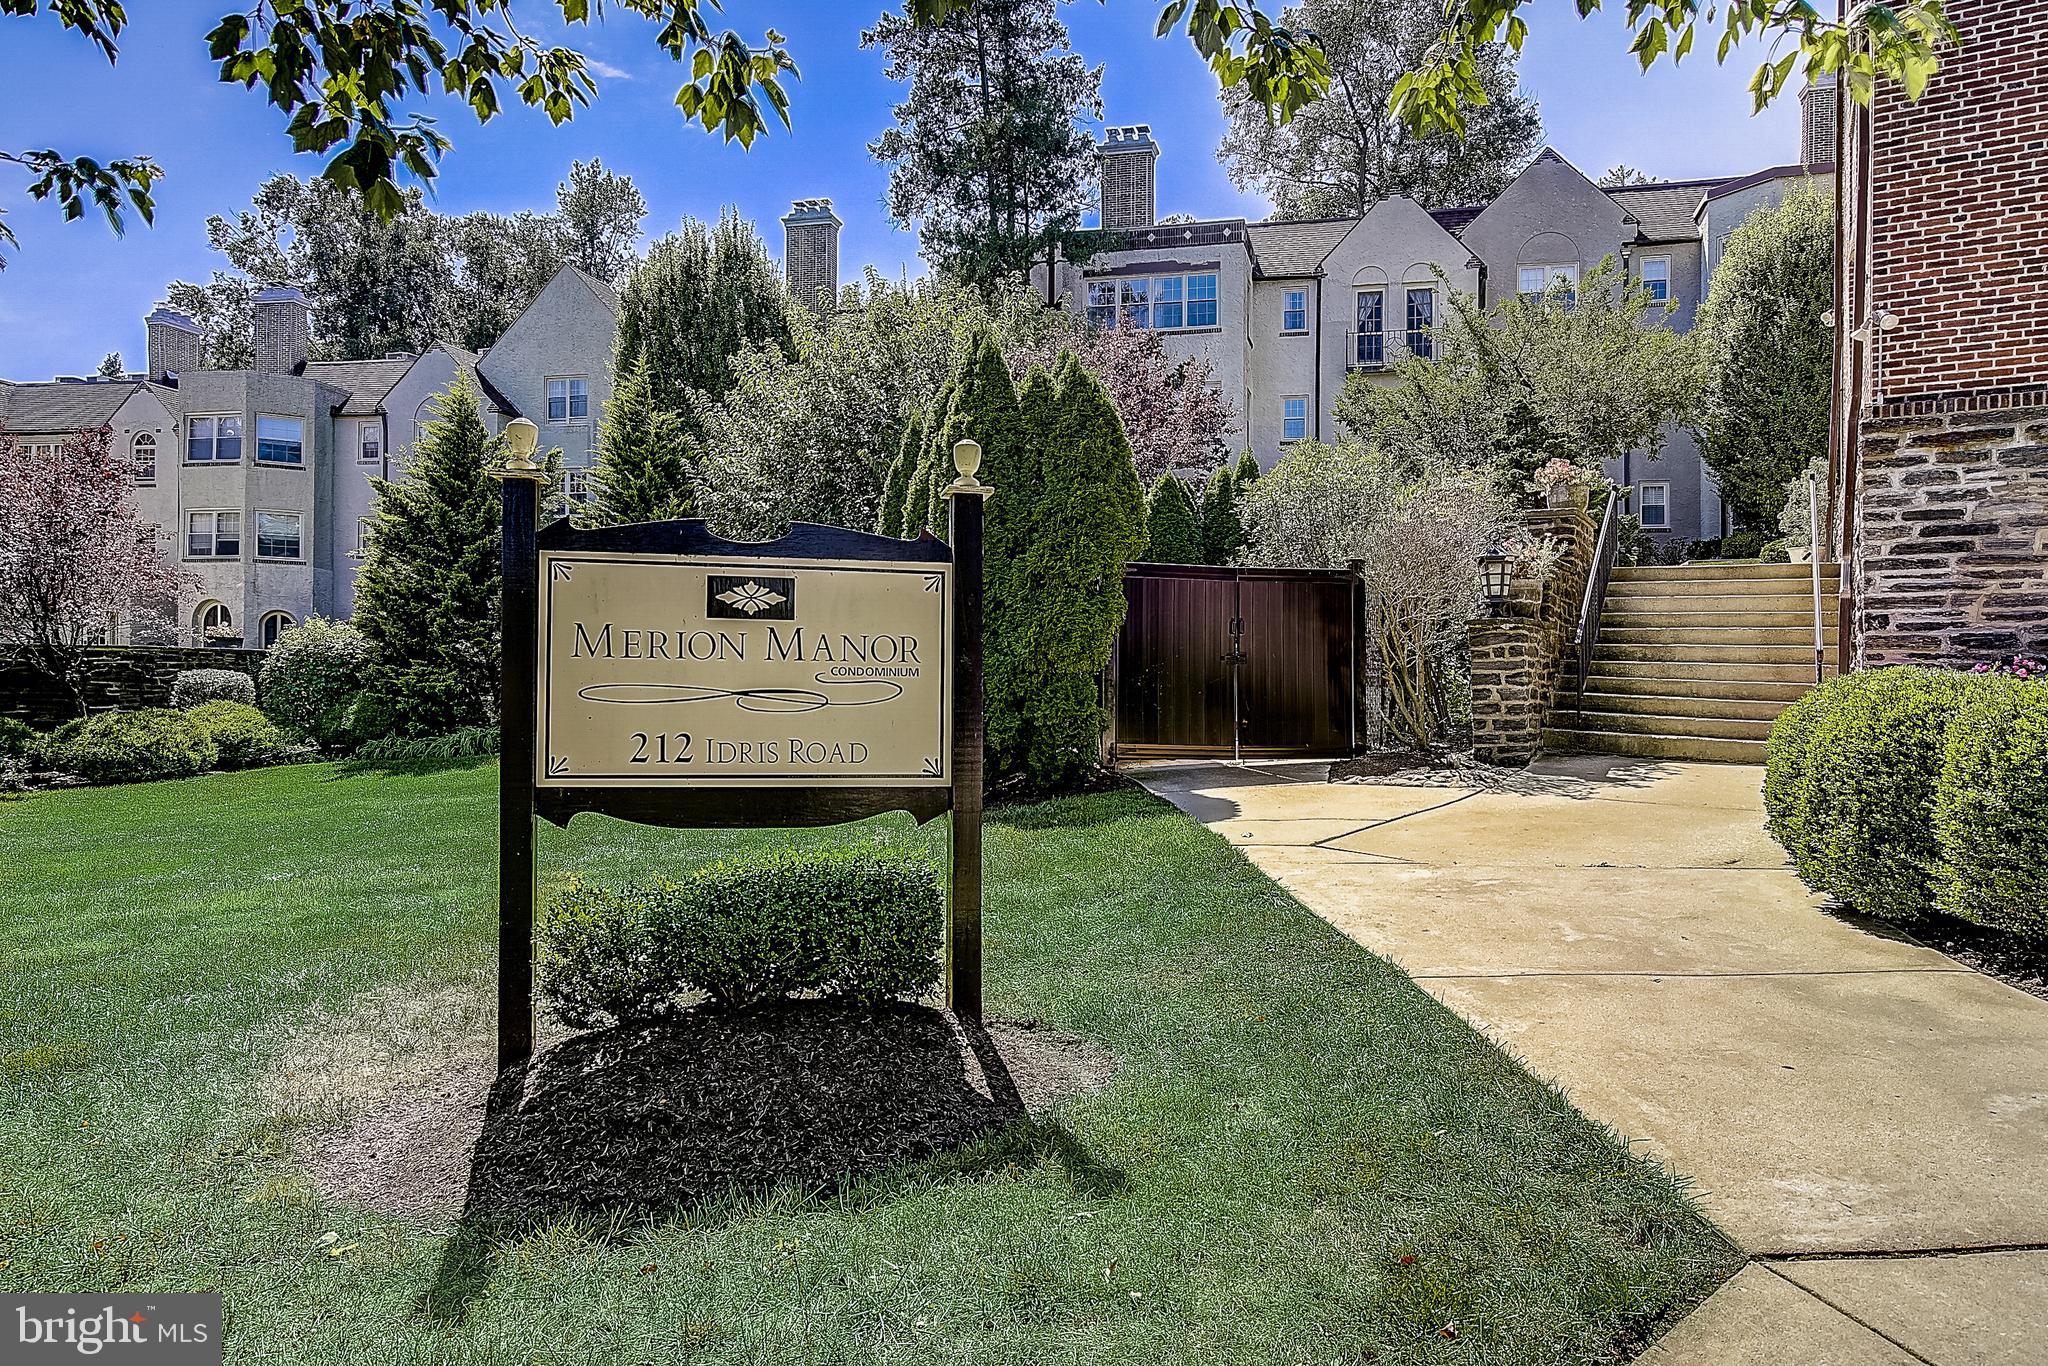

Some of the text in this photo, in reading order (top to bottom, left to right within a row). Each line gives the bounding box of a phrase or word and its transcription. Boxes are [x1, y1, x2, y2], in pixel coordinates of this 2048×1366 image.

[571, 622, 921, 664] MERION MANOR
[830, 666, 920, 678] CONDOMINIUM
[629, 732, 868, 764] 212 IDRIS ROAD
